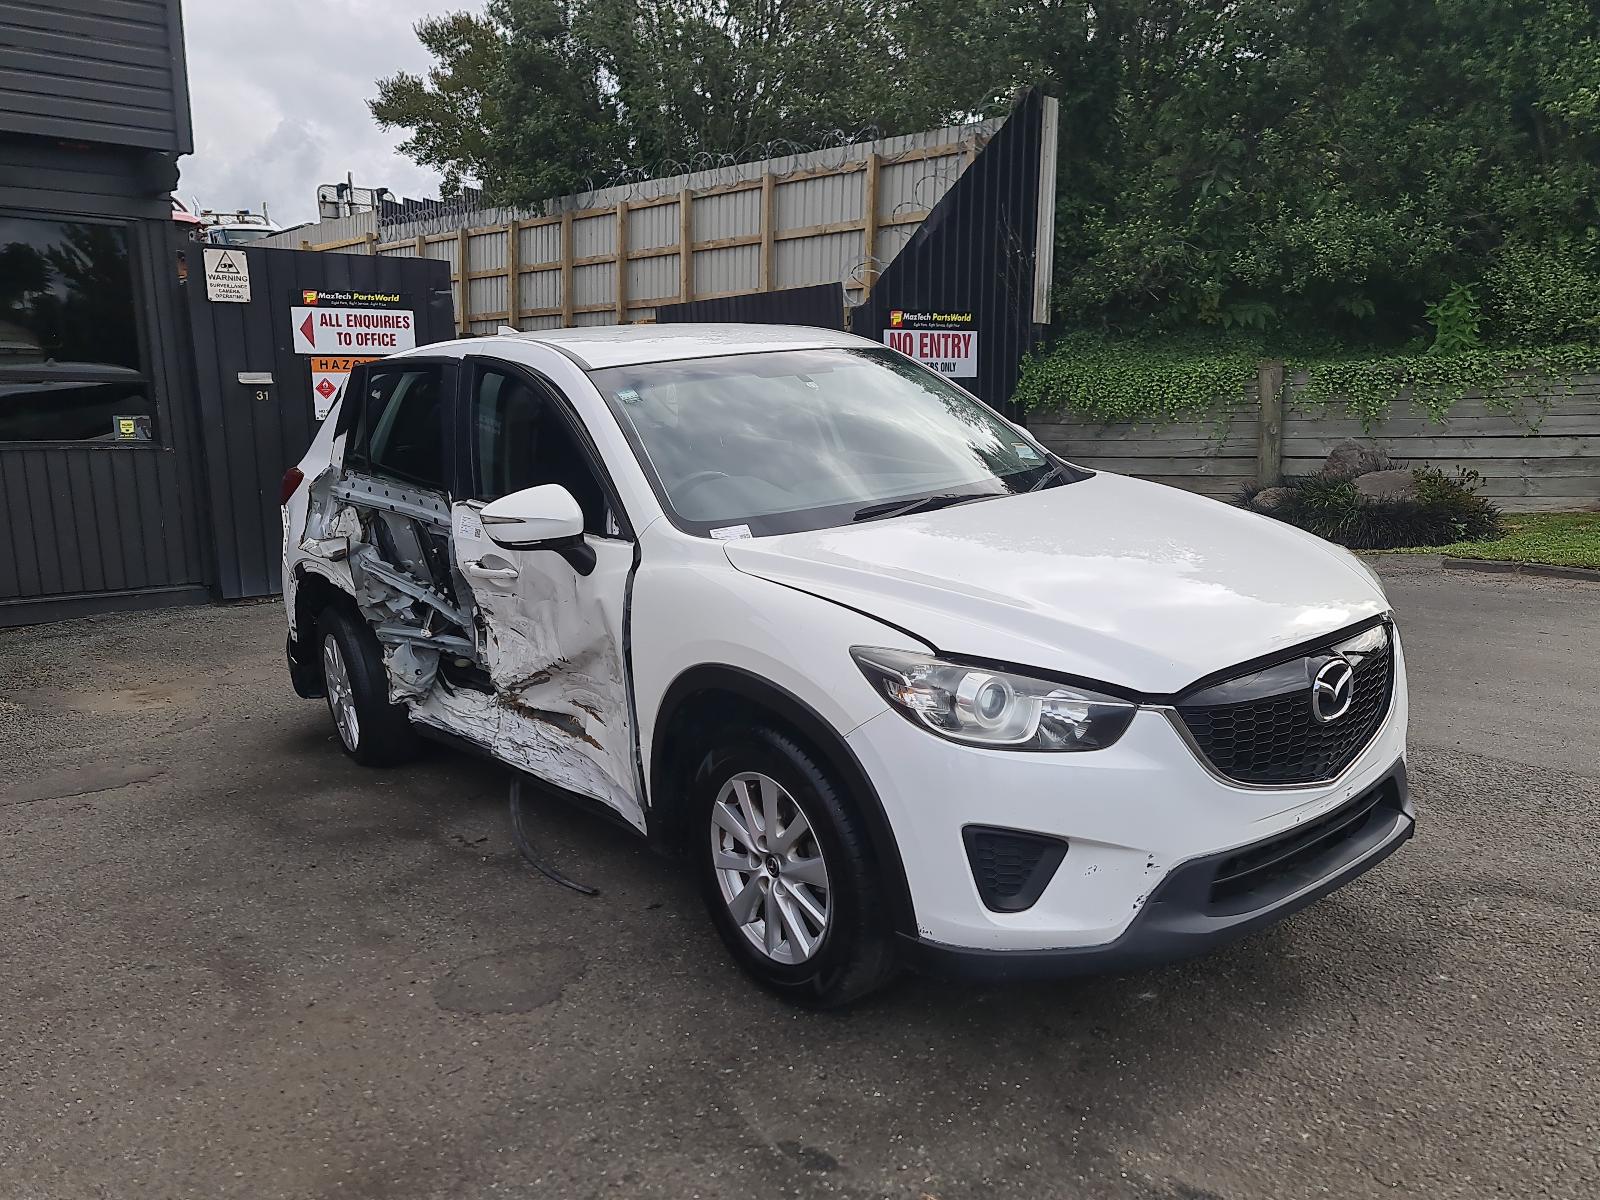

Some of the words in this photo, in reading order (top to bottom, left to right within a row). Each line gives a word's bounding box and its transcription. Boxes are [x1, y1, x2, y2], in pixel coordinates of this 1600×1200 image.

[208, 274, 248, 282] WARNING
[353, 293, 400, 302] PartsWorld
[320, 313, 342, 327] ALL
[346, 313, 410, 329] ENQUIRIES
[903, 313, 931, 321] MazTech
[932, 313, 972, 322] PartsWorld
[337, 332, 352, 346] TO
[356, 332, 396, 346] OFFICE
[890, 332, 914, 357] NO
[920, 332, 972, 358] ENTRY
[940, 362, 956, 372] ONLY
[256, 390, 269, 400] 31
